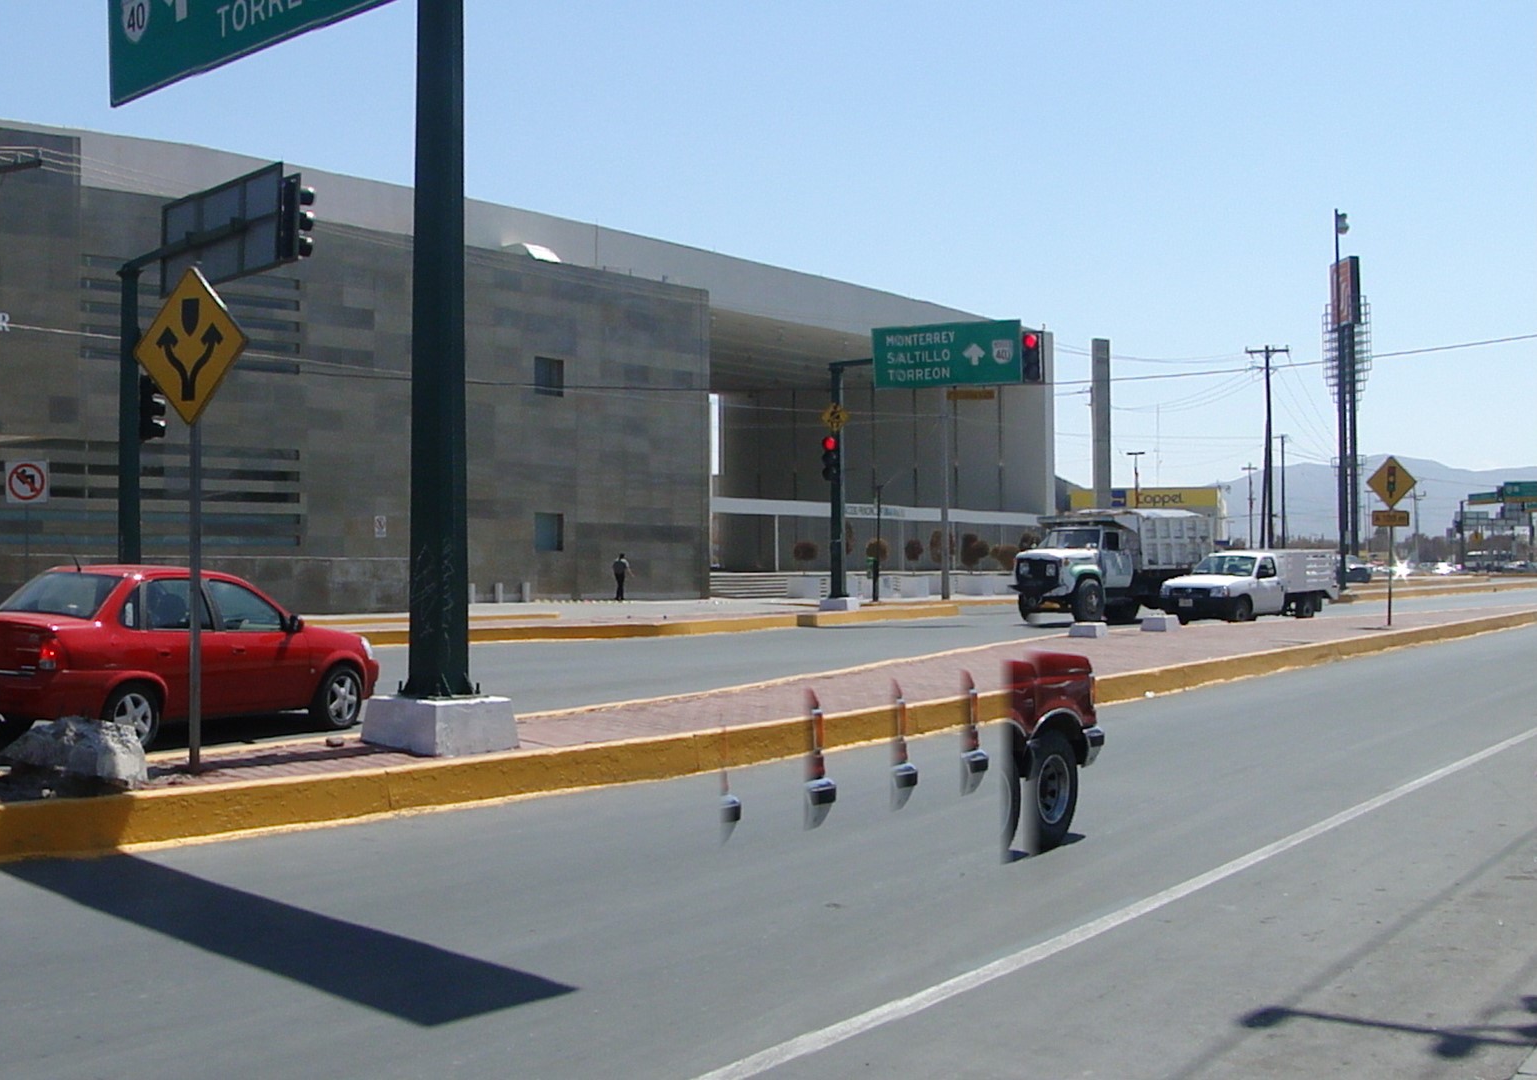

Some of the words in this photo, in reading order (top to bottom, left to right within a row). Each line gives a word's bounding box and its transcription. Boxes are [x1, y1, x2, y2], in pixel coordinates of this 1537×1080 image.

[127, 3, 146, 32] 40
[216, 0, 321, 38] TORR
[885, 331, 955, 346] MONTERREY
[887, 349, 951, 365] SALTILLO
[888, 367, 951, 382] TORREON
